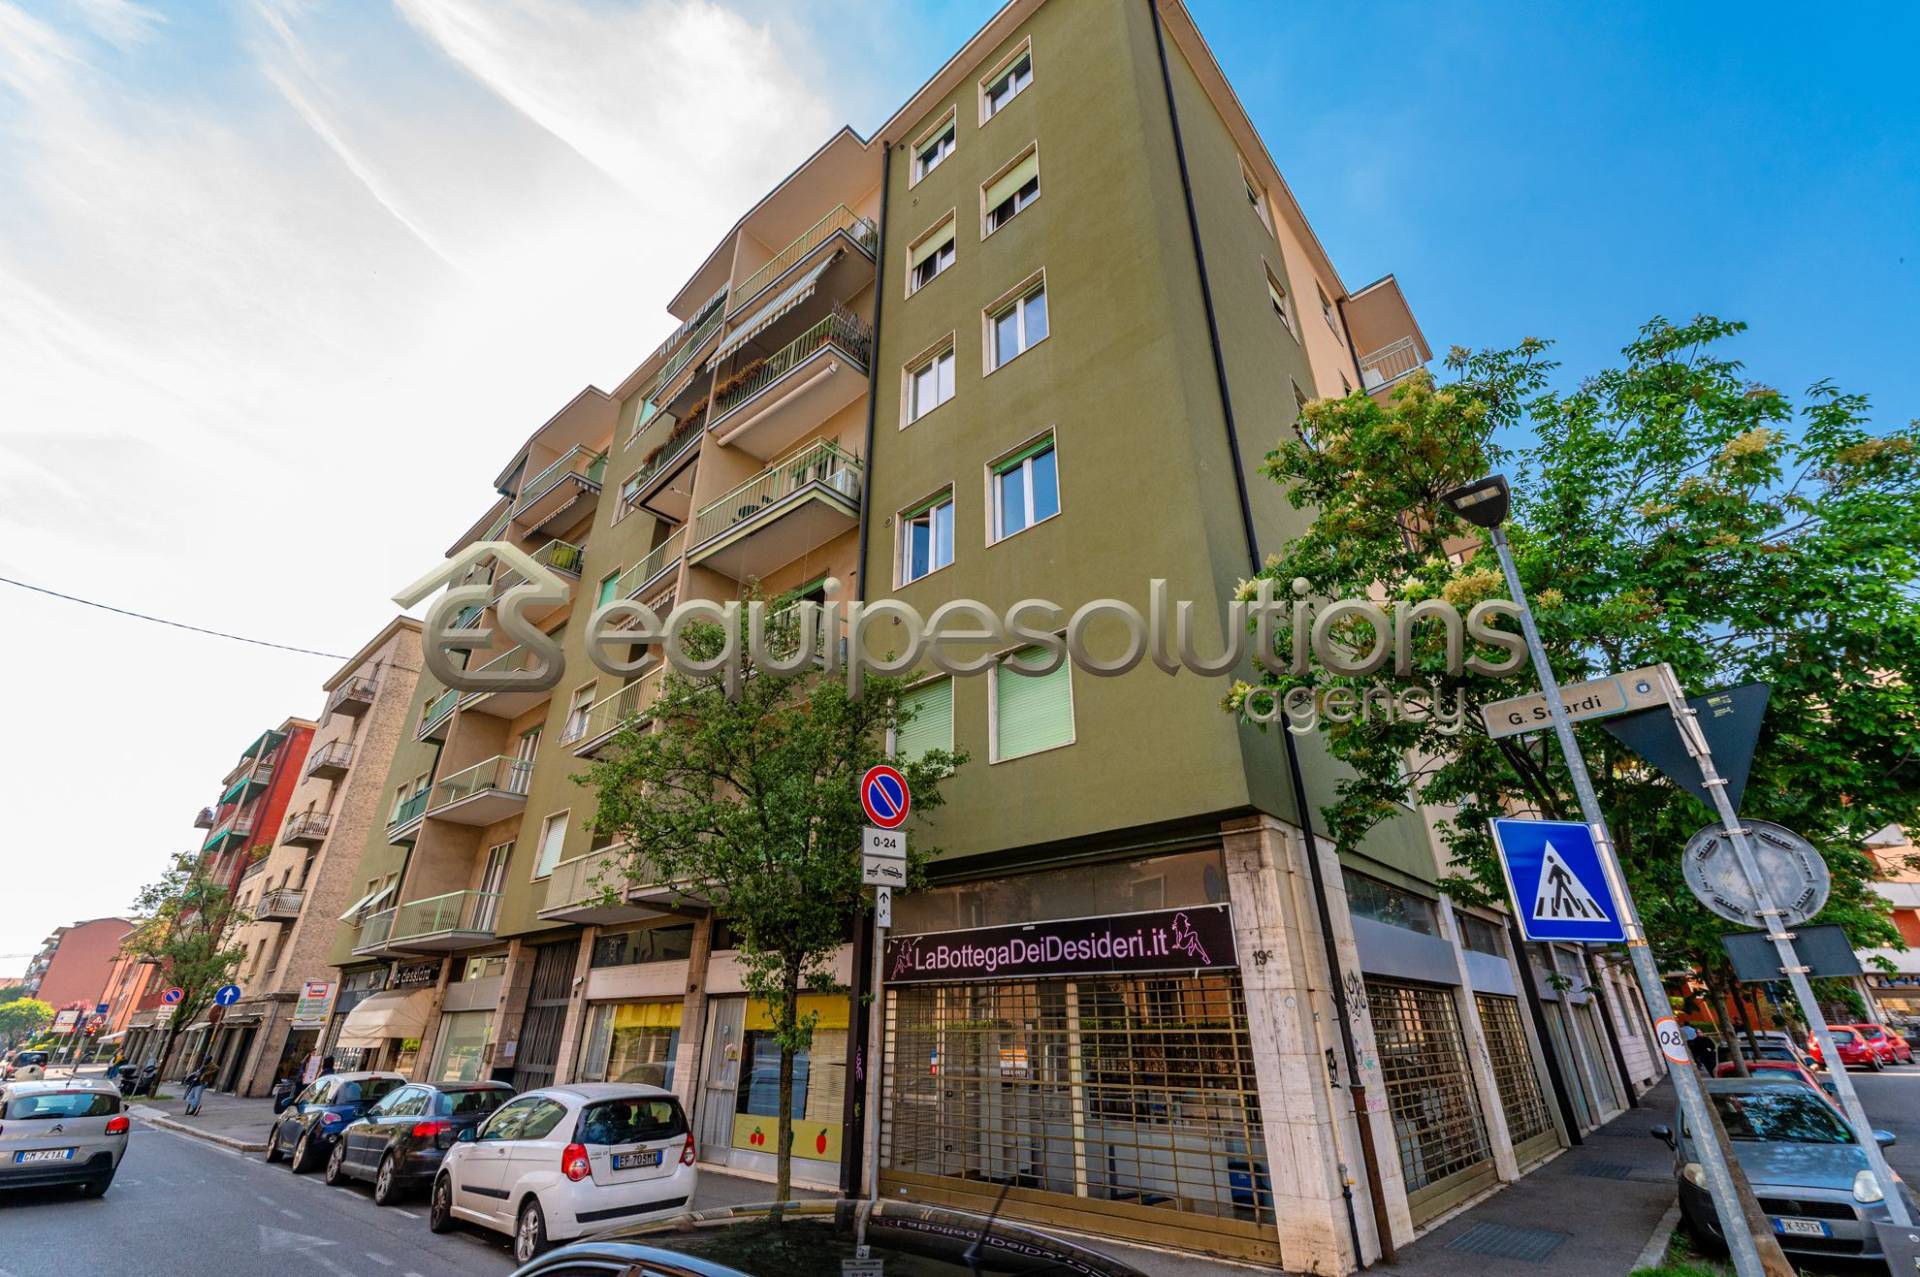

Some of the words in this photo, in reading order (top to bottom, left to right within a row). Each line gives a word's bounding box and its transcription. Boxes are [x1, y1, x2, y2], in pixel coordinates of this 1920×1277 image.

[1508, 712, 1528, 725] G.
[1532, 694, 1602, 720] Sardi
[873, 836, 896, 849] 0-24
[914, 927, 1169, 972] LaBottegaDeiDesideri.it
